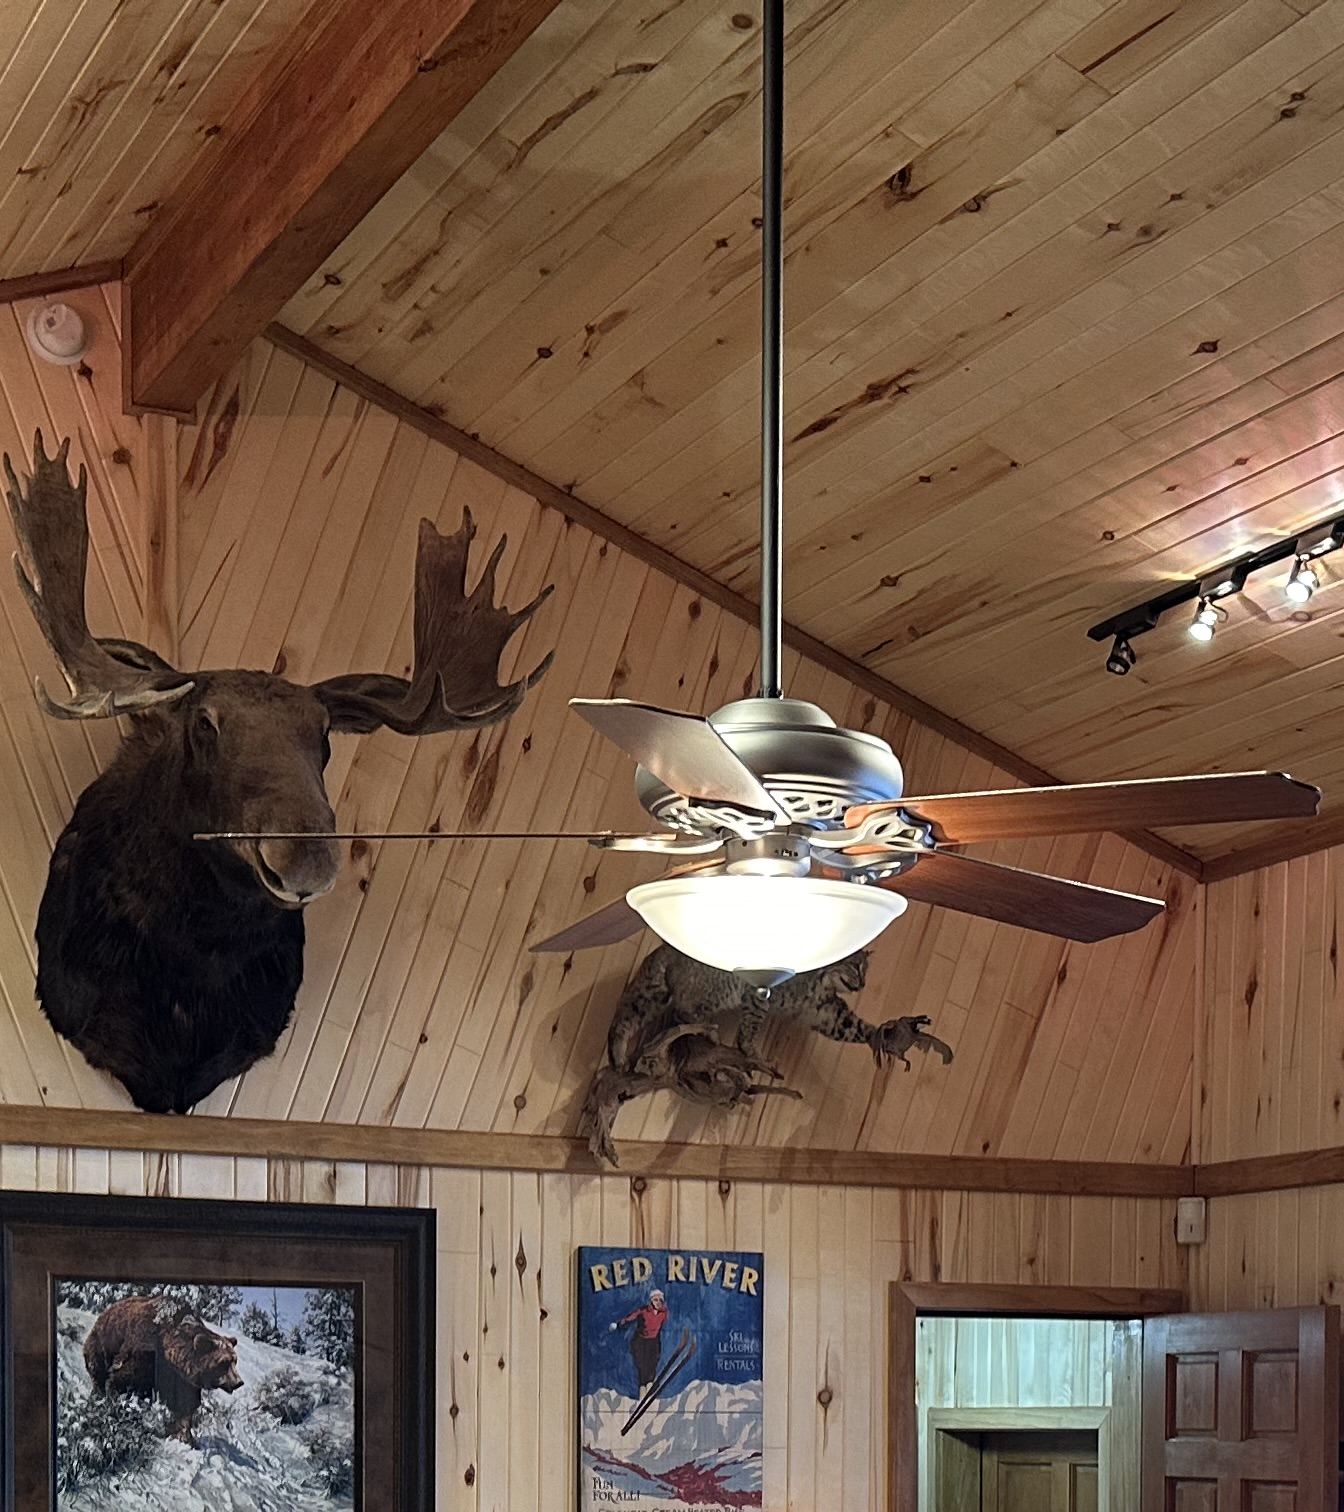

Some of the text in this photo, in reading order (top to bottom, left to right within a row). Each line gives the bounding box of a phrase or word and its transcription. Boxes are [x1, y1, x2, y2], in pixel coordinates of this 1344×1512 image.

[590, 1254, 759, 1297] RED RIVER
[716, 1359, 755, 1371] RENTALS
[592, 1477, 613, 1490] FUN
[592, 1490, 618, 1504] FOR
